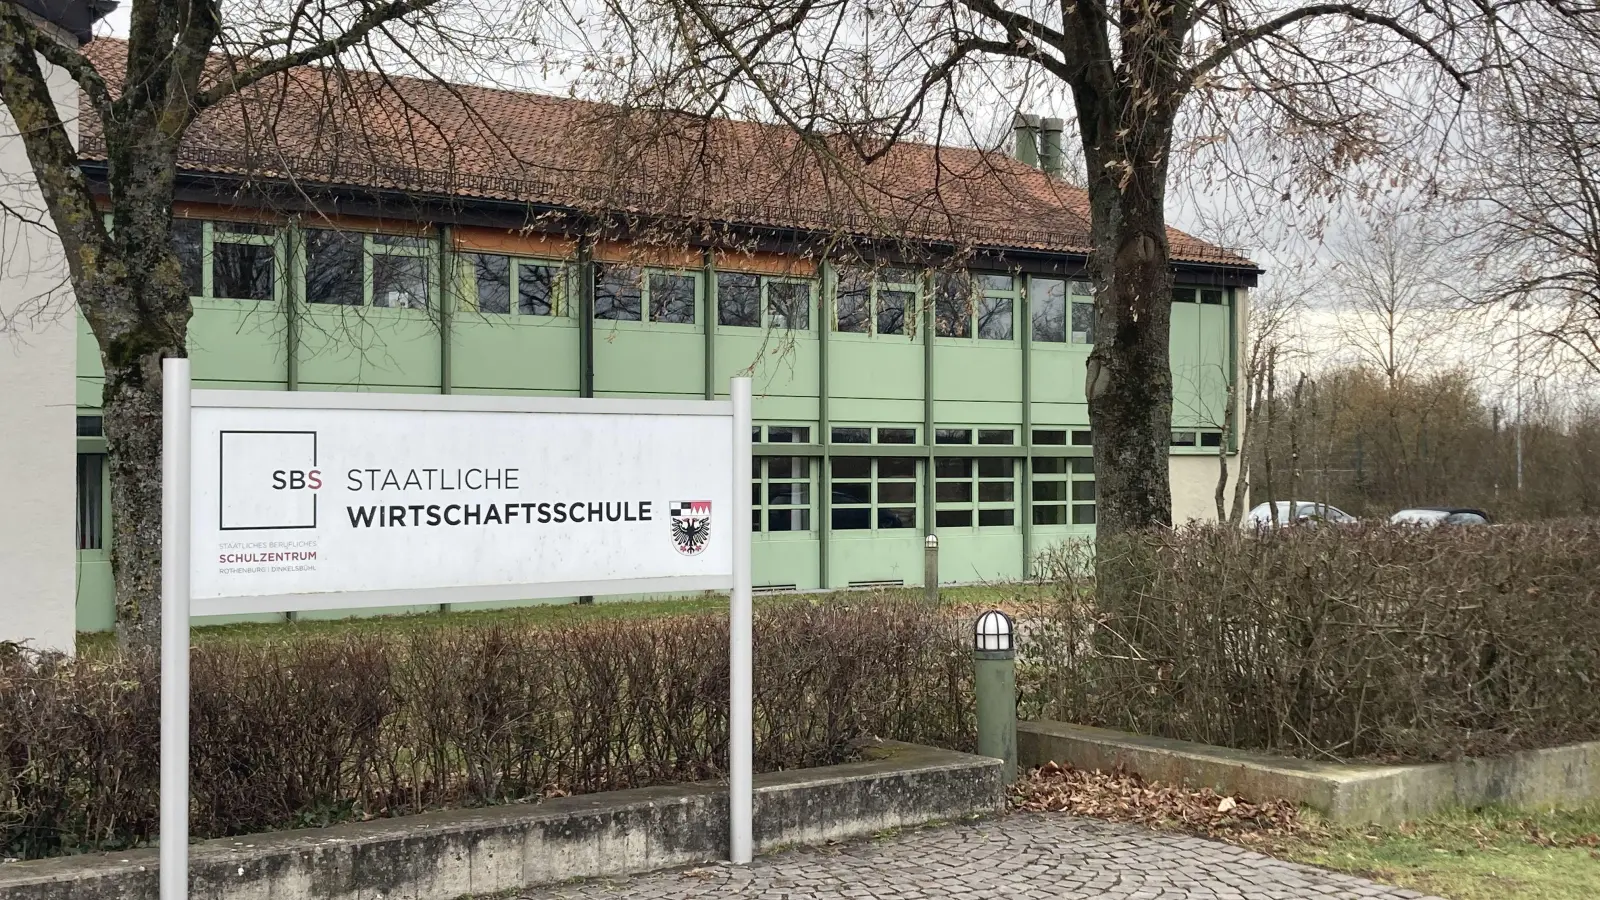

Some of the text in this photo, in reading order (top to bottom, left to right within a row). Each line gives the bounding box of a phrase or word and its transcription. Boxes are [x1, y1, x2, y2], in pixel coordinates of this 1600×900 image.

[271, 469, 323, 490] SBS
[347, 468, 520, 491] STAATLICHE
[346, 501, 652, 528] WIRTSCHAFTSSCHULE
[219, 540, 317, 550] STAATLICHES BERUFLICHES
[219, 551, 317, 564] SCHULZENTRUM
[219, 564, 317, 575] ROTHENBURG DINKELSBÜHL
